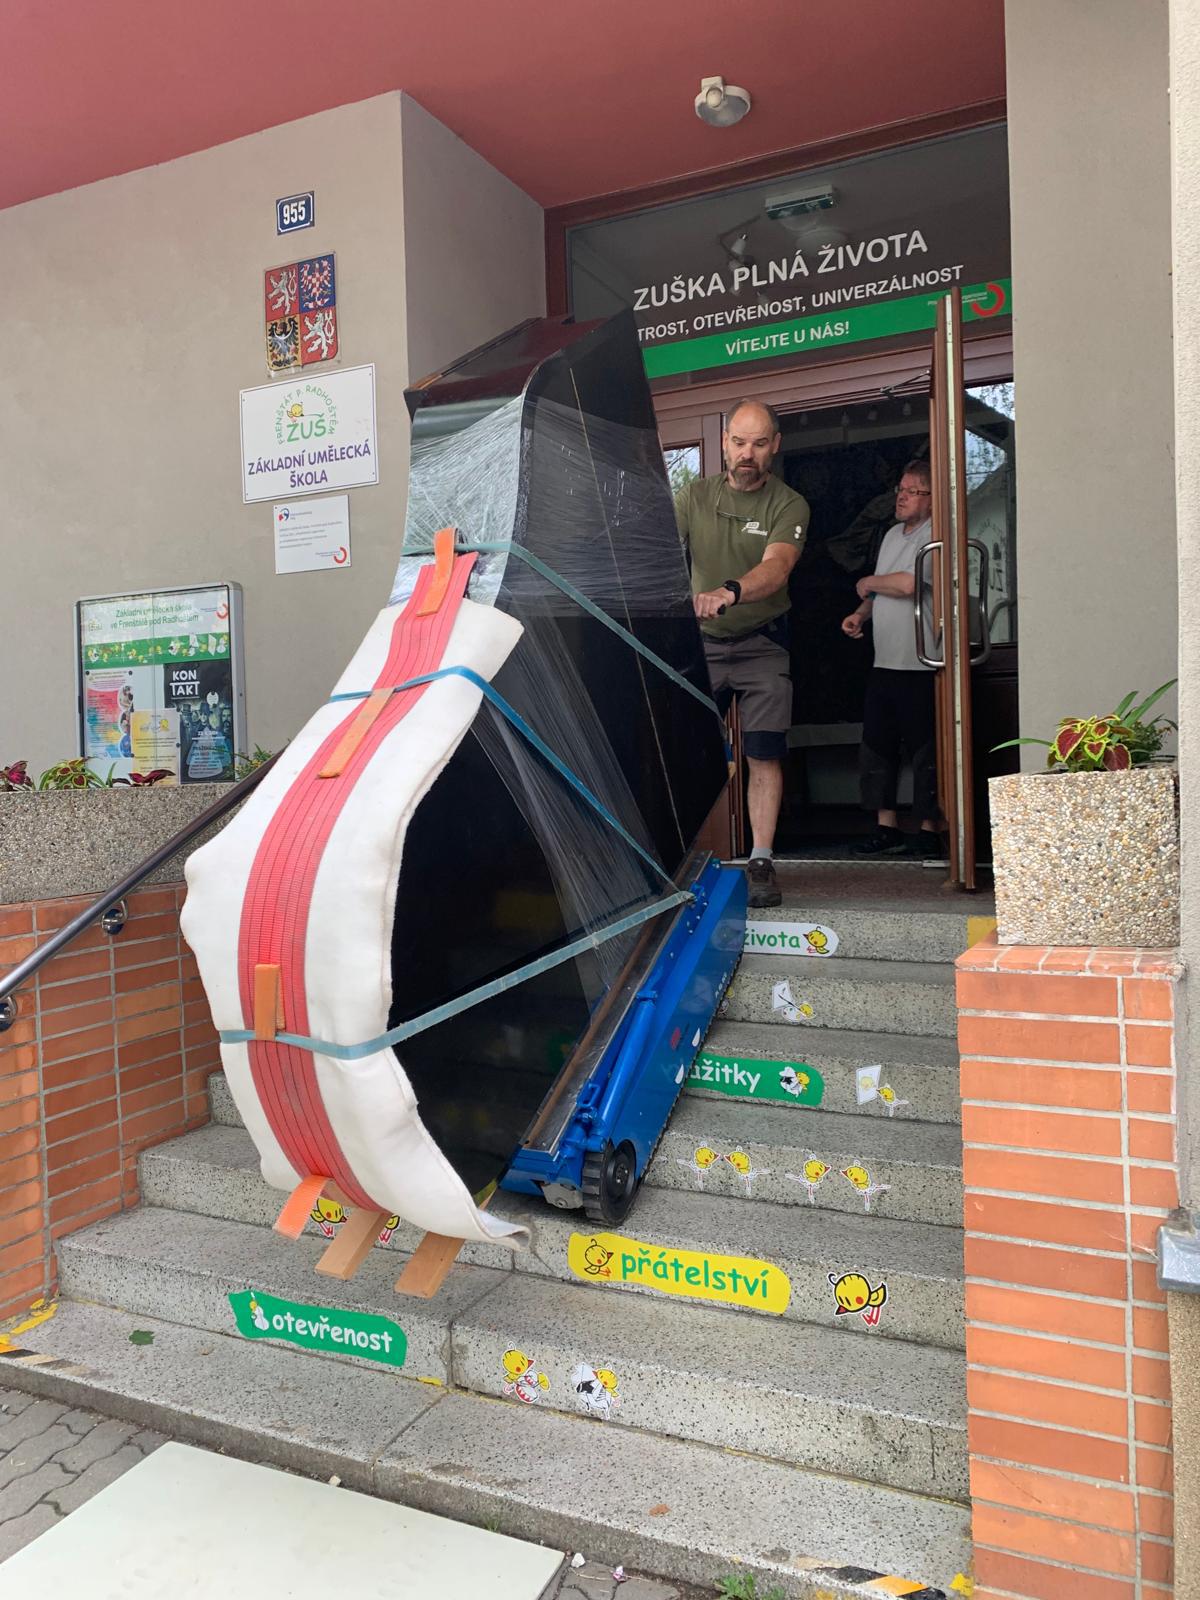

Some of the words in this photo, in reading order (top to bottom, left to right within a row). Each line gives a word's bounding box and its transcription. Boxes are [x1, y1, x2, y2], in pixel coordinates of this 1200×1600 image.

[283, 200, 306, 225] 955
[632, 273, 727, 312] ZUŠKA
[733, 249, 810, 291] PLNÁ
[816, 229, 929, 274] ŽIVOTA
[693, 296, 807, 331] OTEVŘENOST,
[811, 264, 965, 308] UNIVERZÁLNOST
[725, 331, 790, 357] VÍTEJTE
[793, 329, 806, 344] U
[809, 320, 850, 341] NÁS!
[286, 413, 327, 442] ZUŠ
[247, 449, 306, 476] ZÁKLADNÍ
[308, 438, 371, 466] UMĚLECKÁ
[289, 469, 329, 488] ŠKOLA
[169, 681, 200, 696] TAKT
[172, 669, 197, 681] KON
[621, 1247, 769, 1298] přátelství
[272, 1311, 393, 1353] otevřenost
